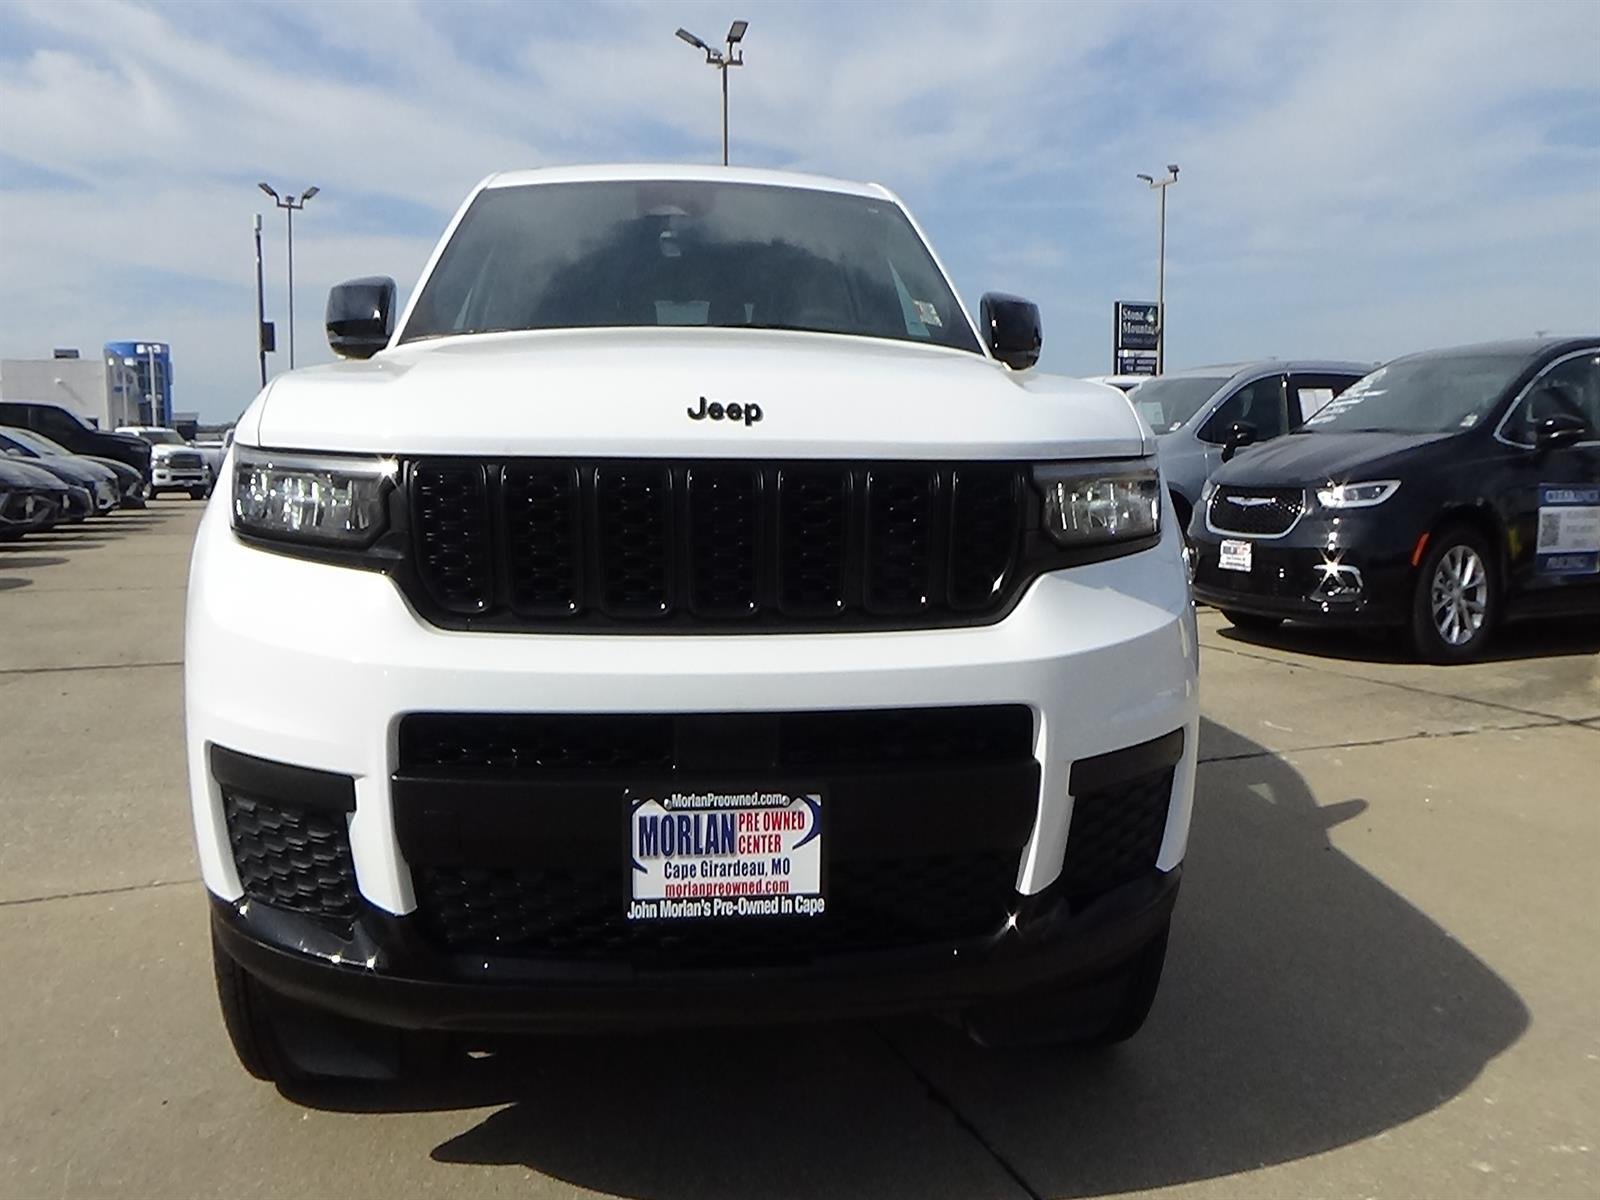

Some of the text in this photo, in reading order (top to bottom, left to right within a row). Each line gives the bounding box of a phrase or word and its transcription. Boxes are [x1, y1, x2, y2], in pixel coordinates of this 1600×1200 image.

[687, 396, 764, 427] Jeep
[671, 792, 783, 808] MorlanPreowned.com
[738, 810, 805, 832] PRE OWNED
[639, 813, 735, 857] MORLAN
[738, 834, 782, 854] CENTER
[664, 857, 791, 880] Cape Girardeau, MO
[665, 880, 789, 898] morlanpreowned.com
[627, 895, 825, 919] John Morlan's Pre-Owned in Cape
